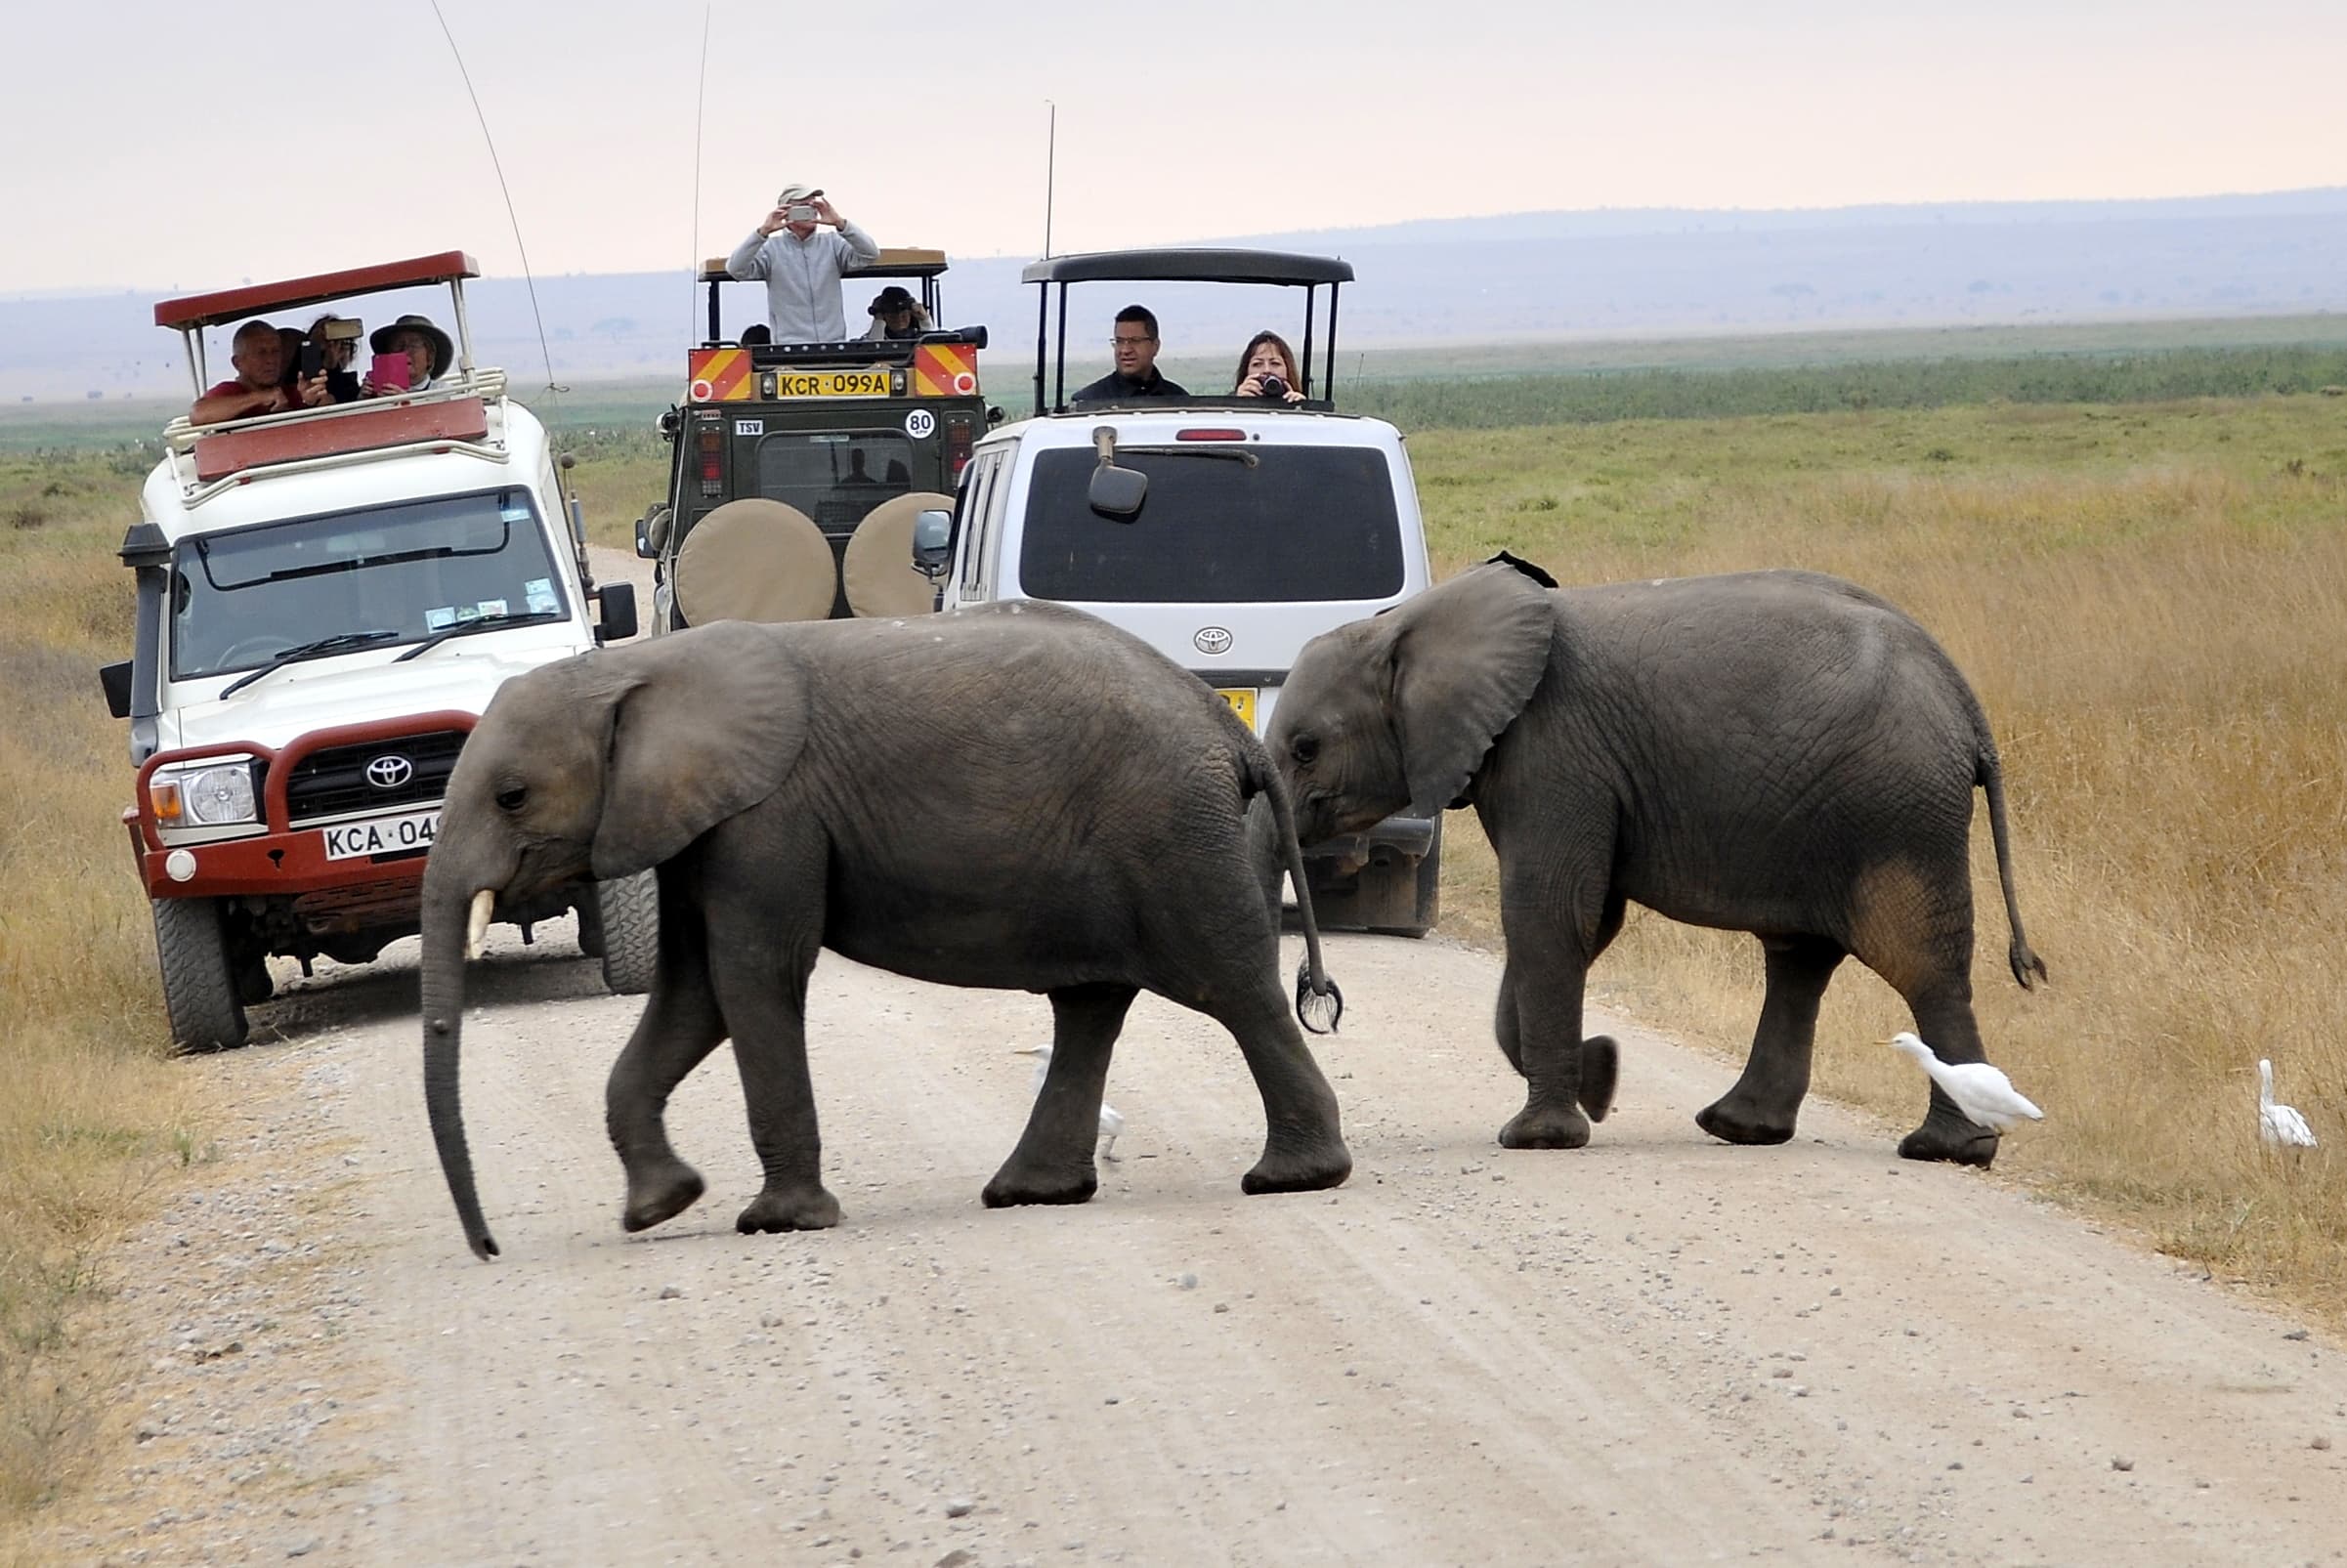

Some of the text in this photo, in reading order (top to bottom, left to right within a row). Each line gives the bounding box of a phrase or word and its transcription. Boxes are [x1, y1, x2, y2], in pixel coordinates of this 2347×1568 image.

[782, 374, 885, 395] KCR 099A
[739, 422, 760, 434] TSV
[910, 414, 931, 431] 80
[327, 818, 442, 856] KCA 04
